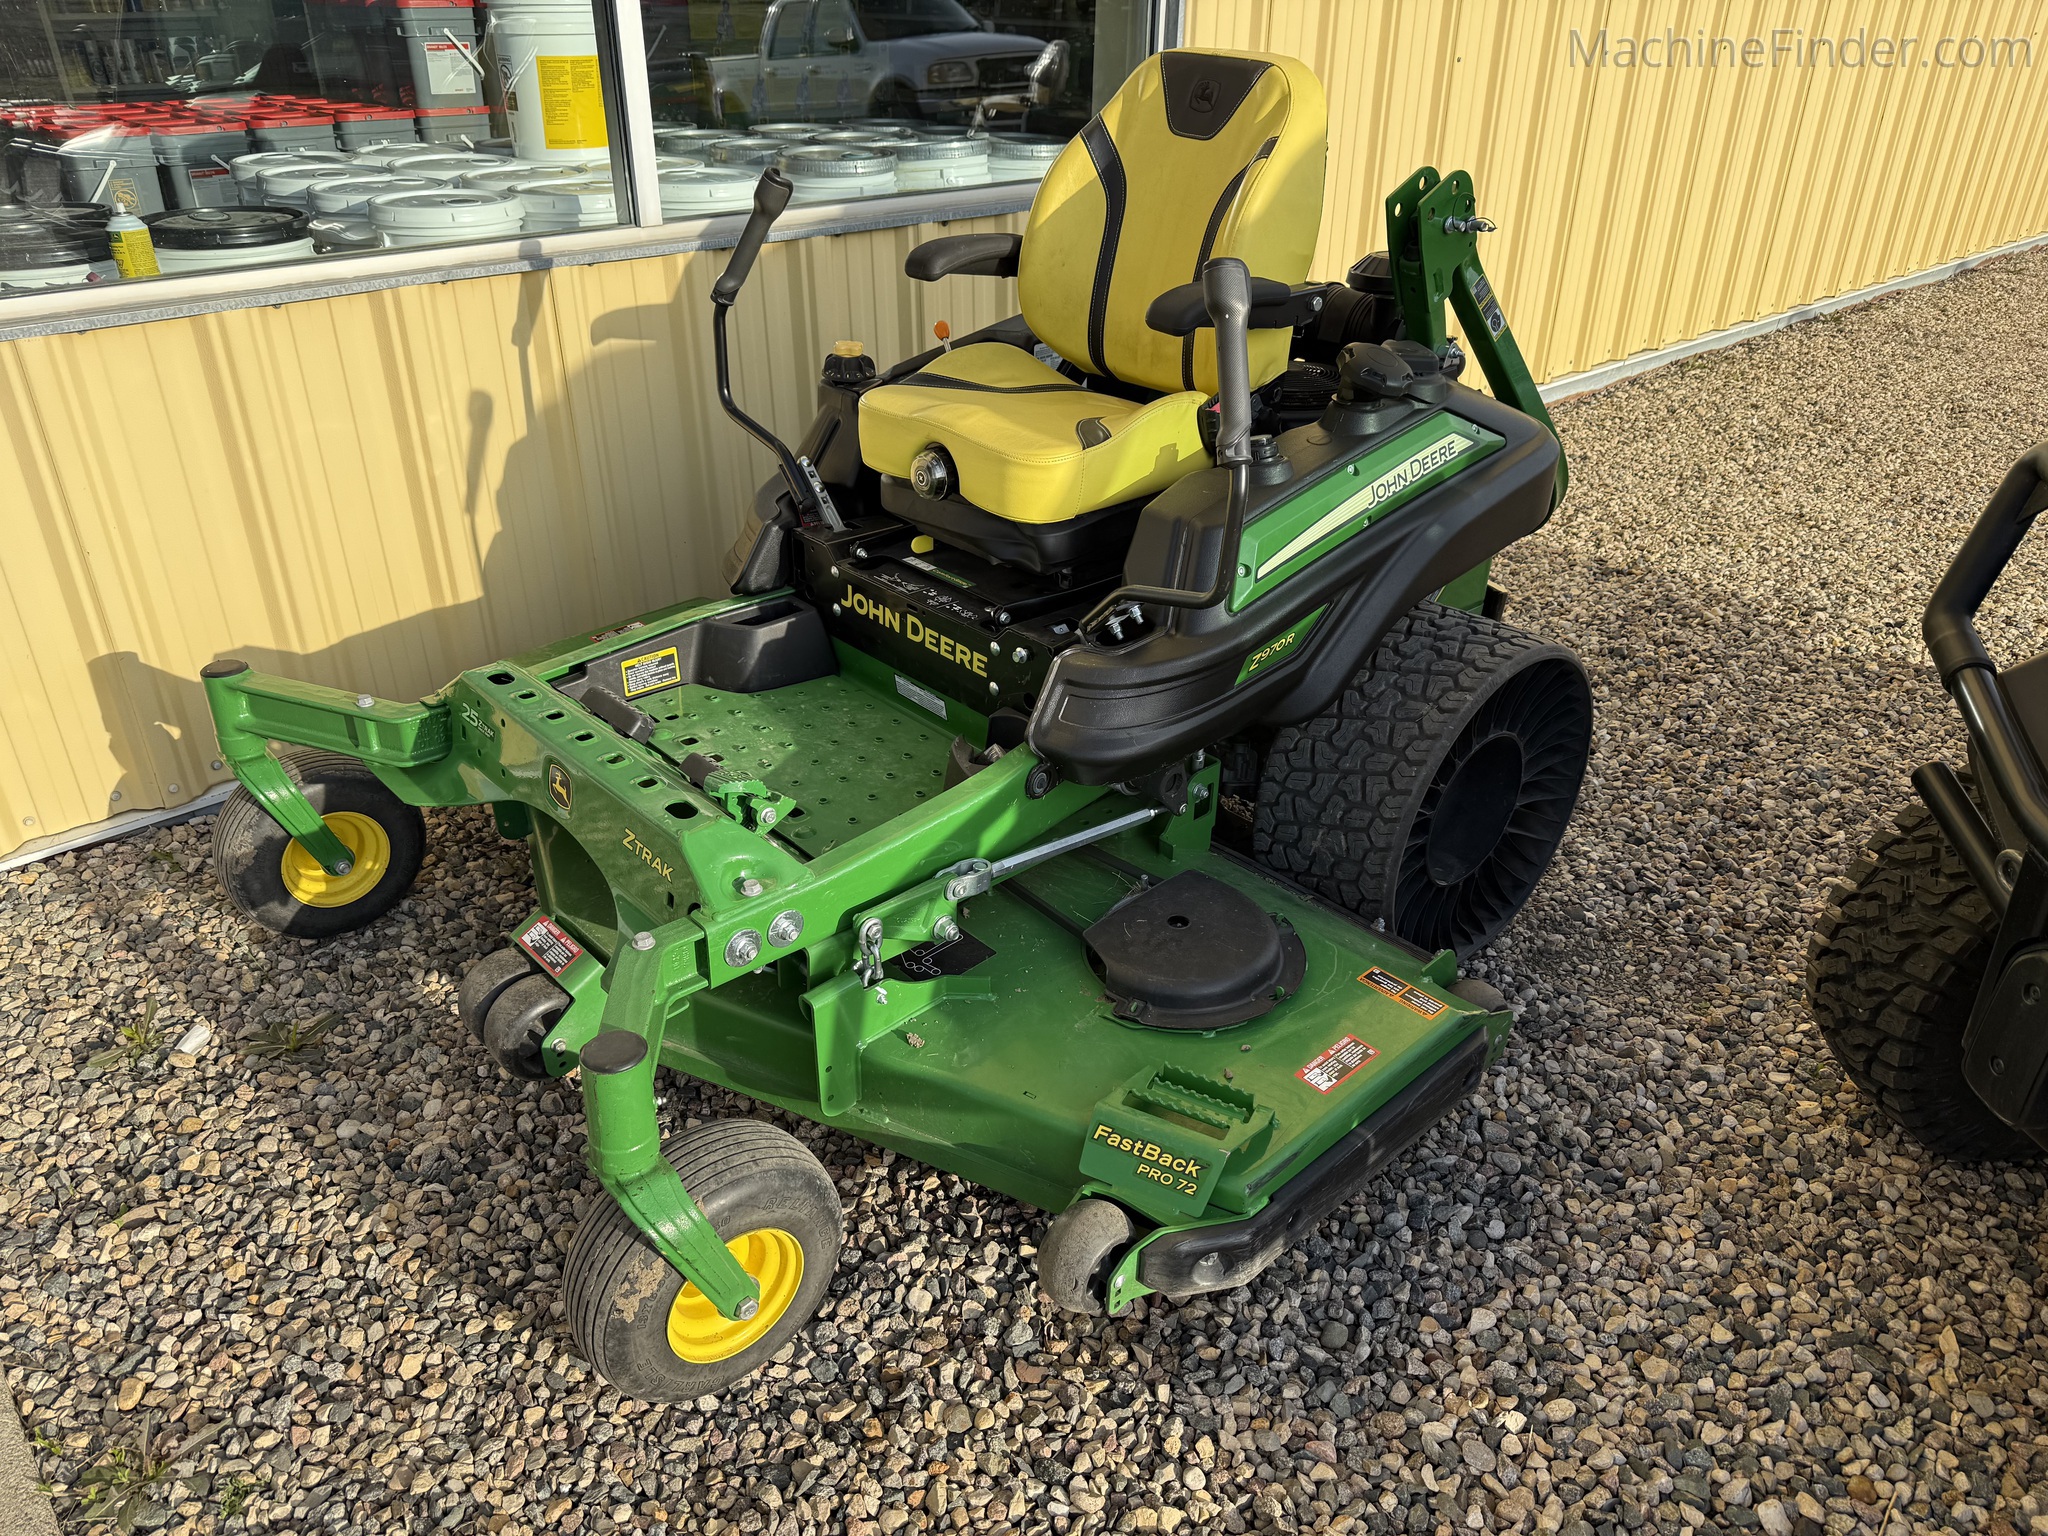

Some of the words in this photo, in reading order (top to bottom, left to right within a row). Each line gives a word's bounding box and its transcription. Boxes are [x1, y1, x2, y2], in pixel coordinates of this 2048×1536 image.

[1368, 469, 1408, 506] JOHN
[1410, 440, 1457, 479] DEERE
[841, 584, 900, 633] JOHN
[906, 613, 988, 678] DEERE
[1248, 632, 1296, 672] Z970R
[461, 702, 479, 727] 25
[622, 828, 674, 882] ZTRAK
[1093, 1124, 1202, 1178] FastBack
[1136, 1163, 1174, 1186] PRO
[1176, 1178, 1198, 1196] 72
[763, 1197, 833, 1250] RELIANCE
[637, 1358, 725, 1393] CARLISLE
